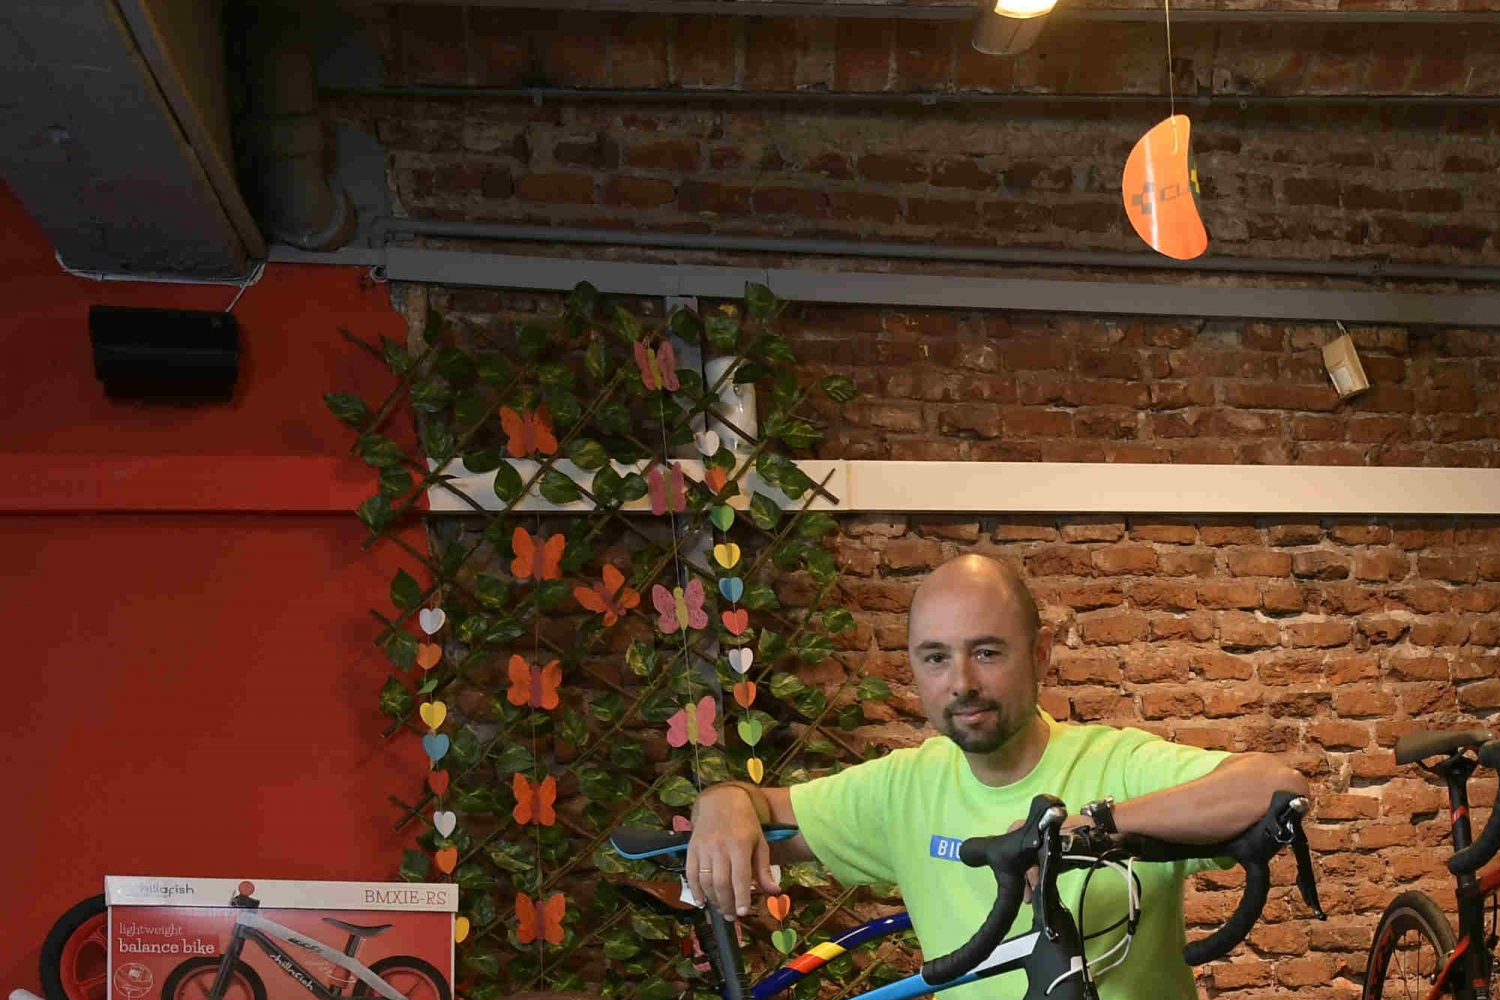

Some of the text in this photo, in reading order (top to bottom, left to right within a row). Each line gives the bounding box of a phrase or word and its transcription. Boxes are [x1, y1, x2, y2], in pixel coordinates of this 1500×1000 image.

[138, 883, 194, 897] hillafish
[365, 889, 447, 905] BMXIE-RS
[119, 922, 183, 937] lightweight
[119, 937, 215, 954] balance bike
